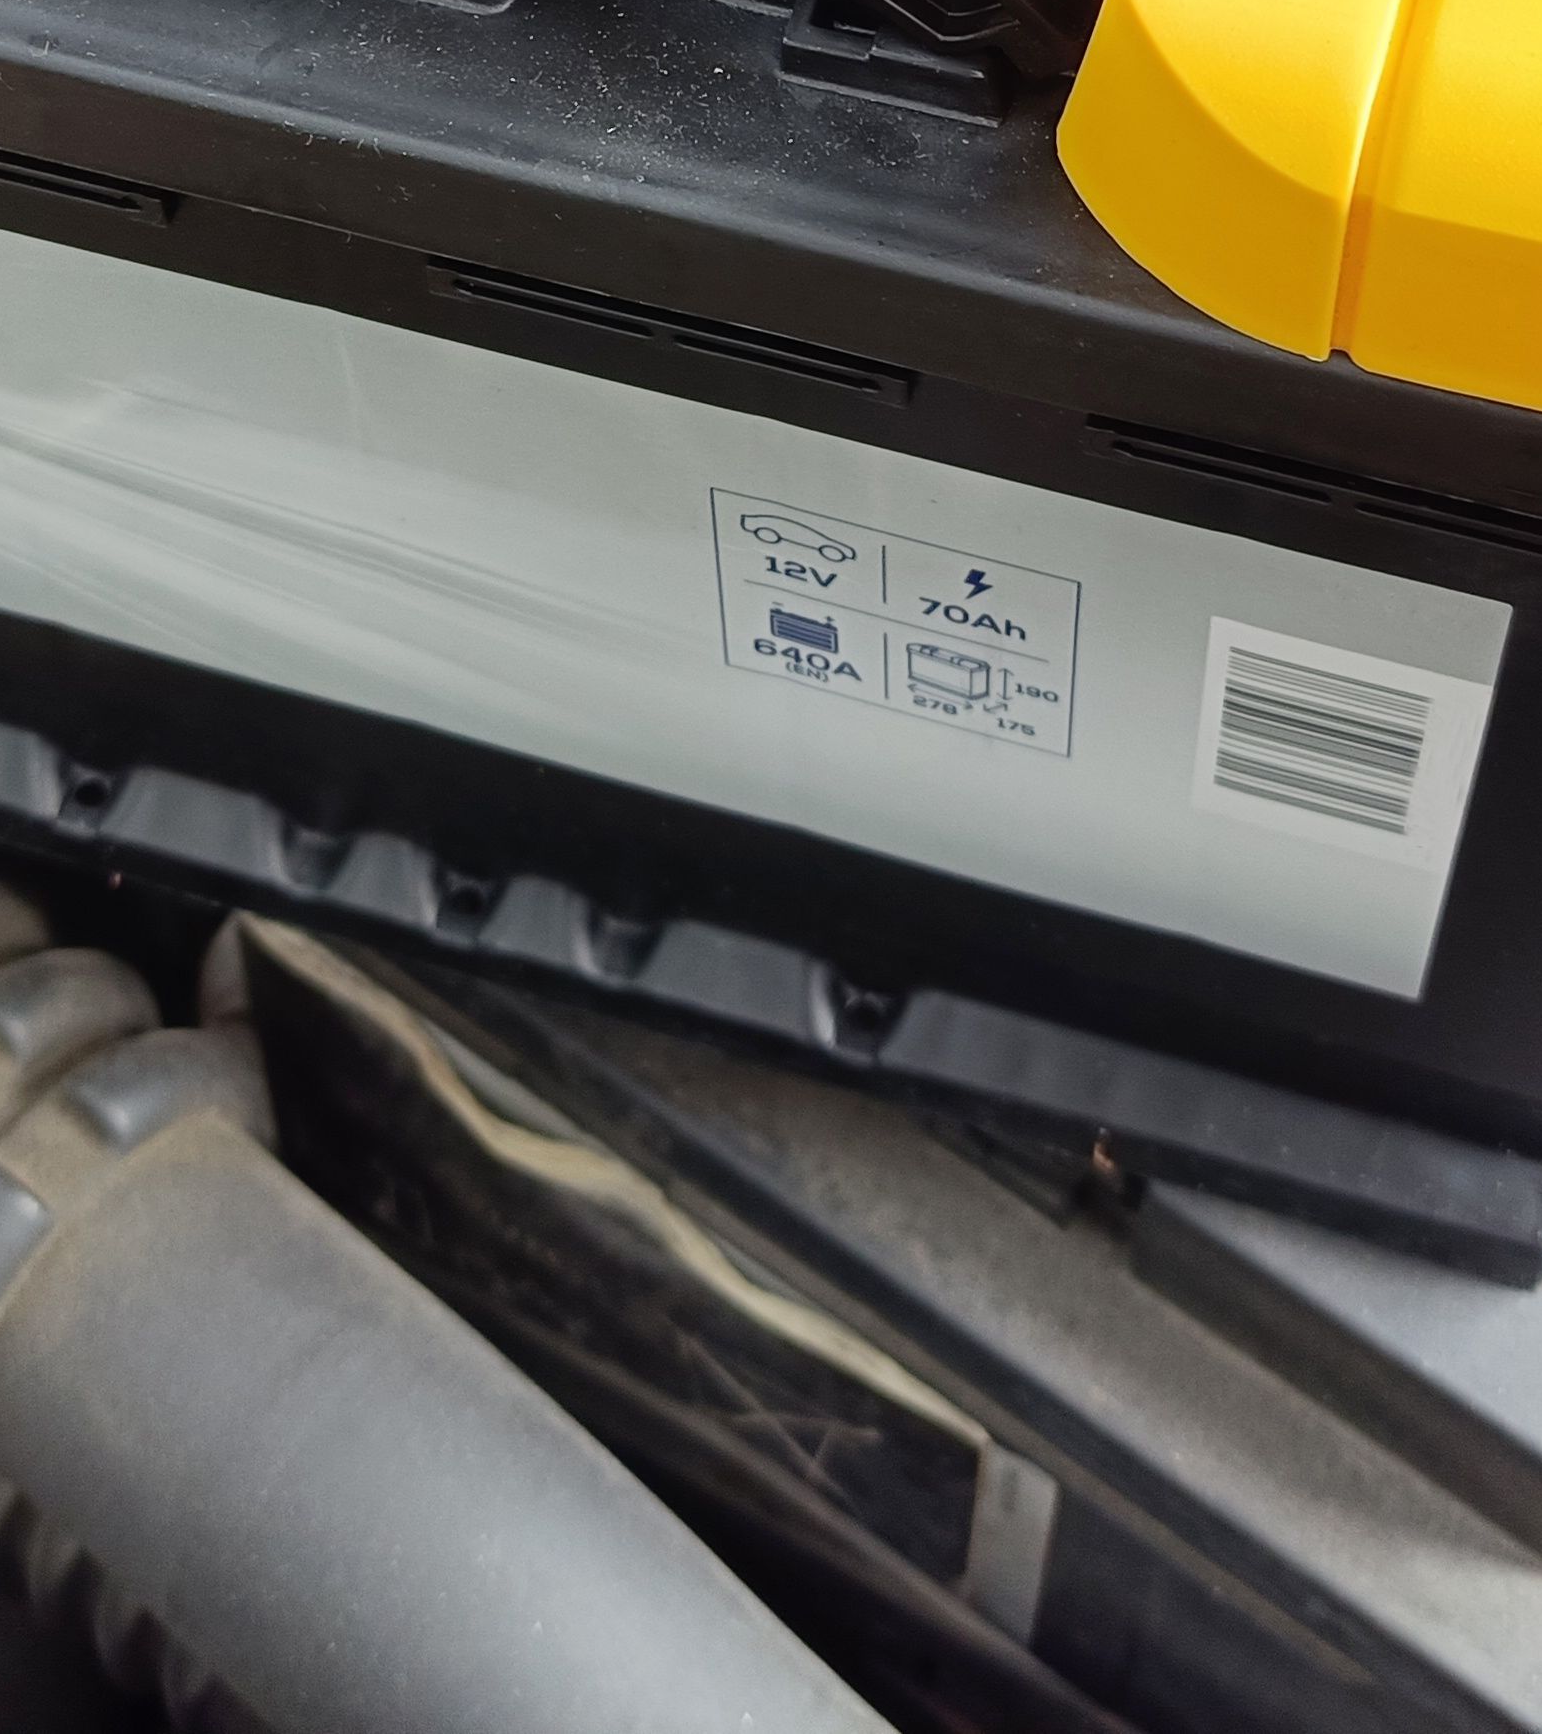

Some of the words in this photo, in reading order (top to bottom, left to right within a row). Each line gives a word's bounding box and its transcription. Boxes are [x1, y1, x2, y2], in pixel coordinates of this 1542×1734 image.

[765, 555, 838, 588] 12V
[918, 596, 1027, 641] 70Ah
[753, 639, 862, 682] 640A
[786, 661, 830, 683] (EN)
[912, 695, 957, 716] 278
[995, 717, 1035, 737] 175
